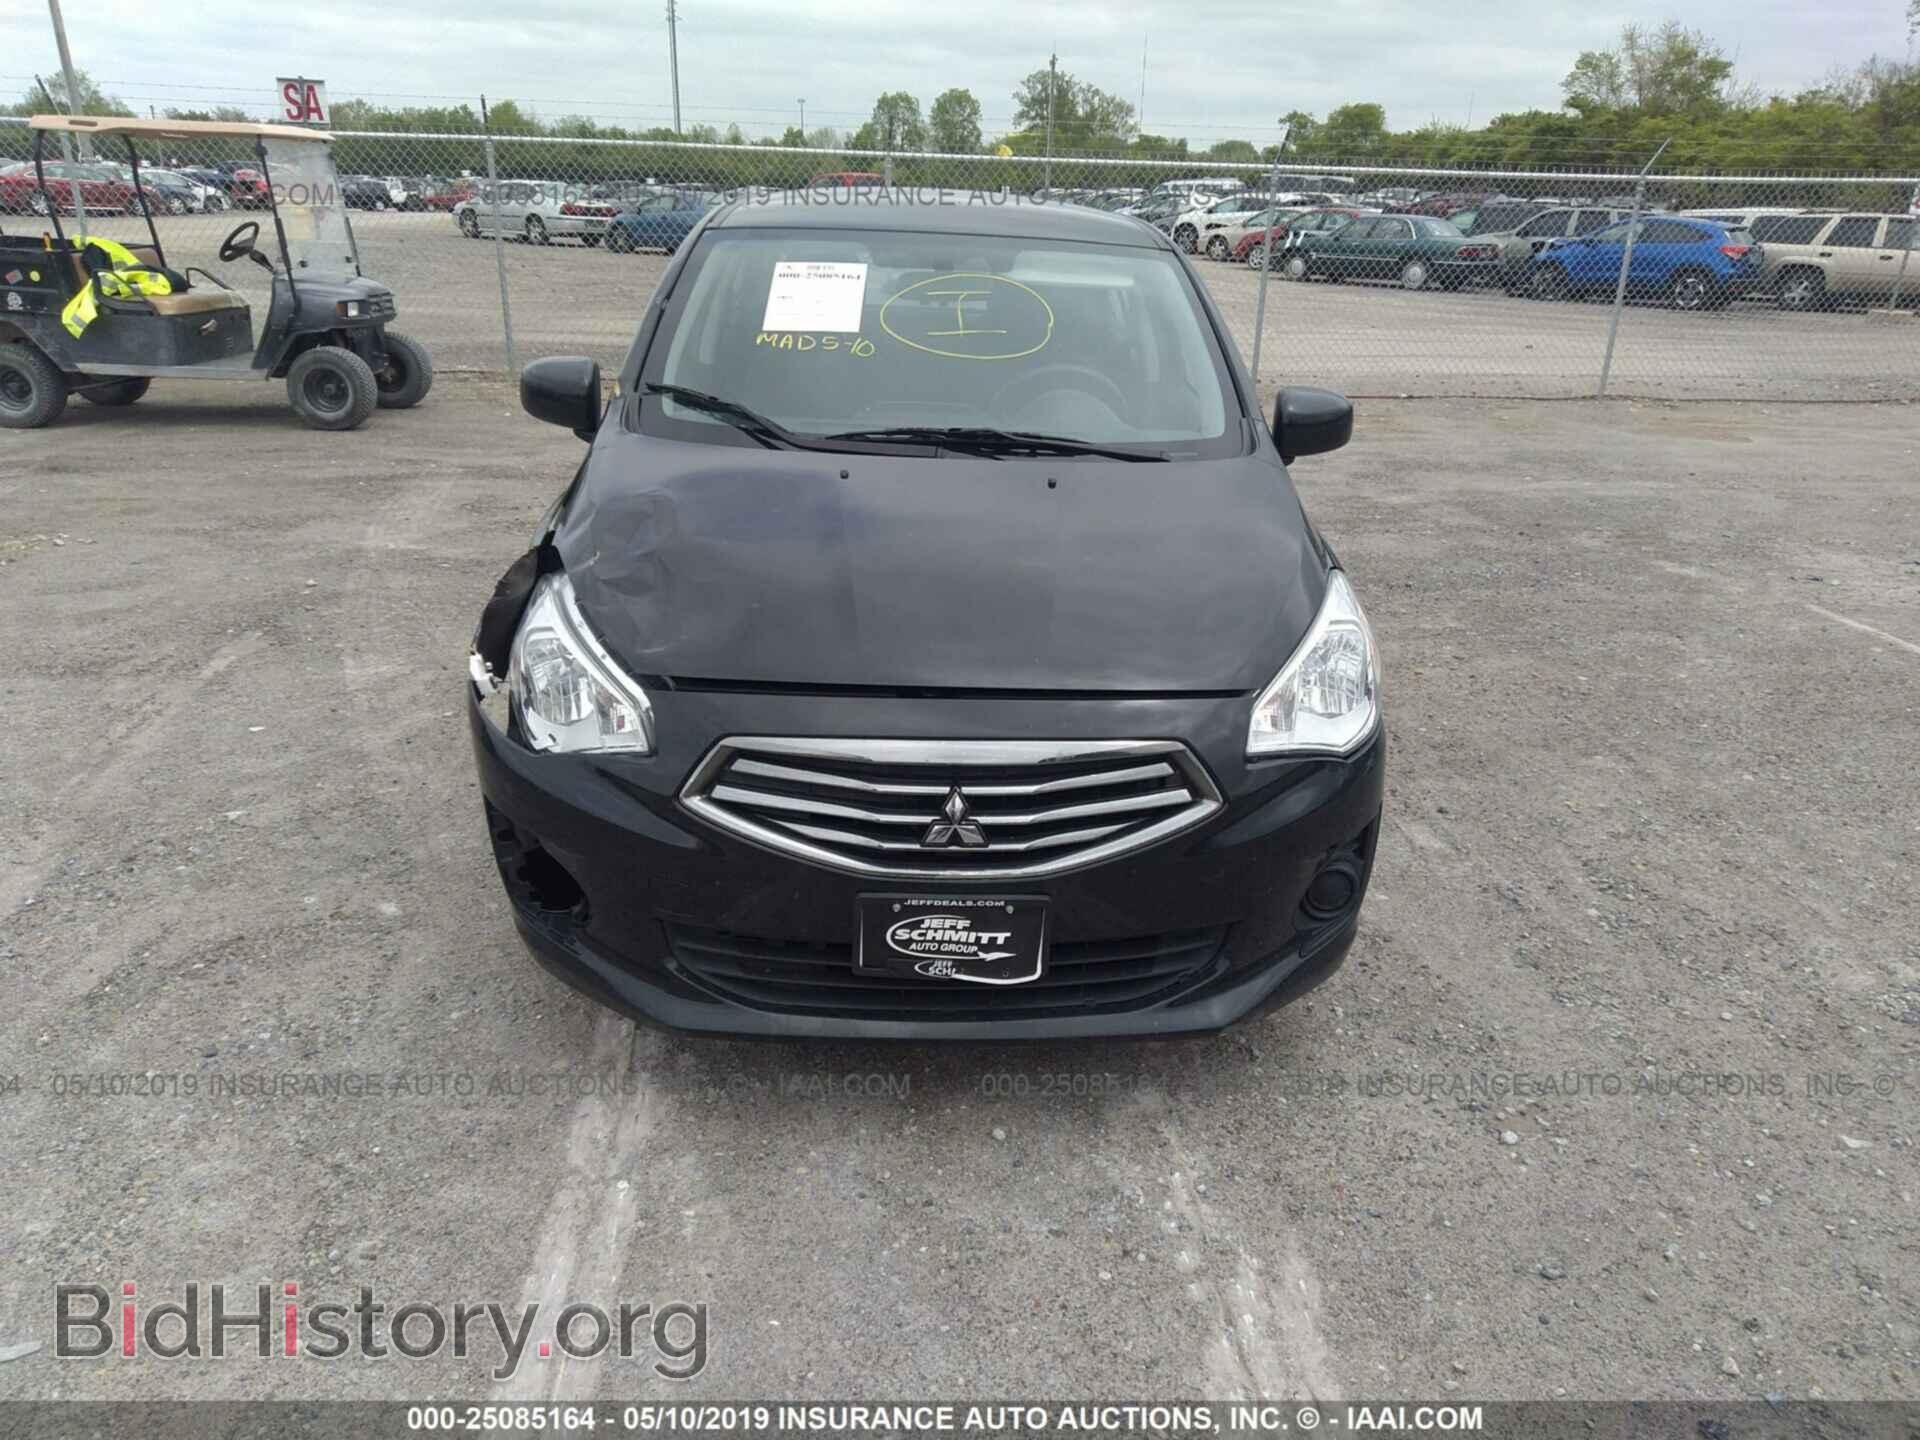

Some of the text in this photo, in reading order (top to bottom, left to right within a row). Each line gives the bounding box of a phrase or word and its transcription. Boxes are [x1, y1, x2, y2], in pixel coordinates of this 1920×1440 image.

[283, 83, 324, 121] SA
[756, 333, 817, 351] MAD
[904, 899, 1005, 907] JEFFDEALS.COM
[920, 918, 972, 930] JEFF
[894, 928, 1012, 945] SCHMITT
[908, 942, 979, 954] AUTO GROUP
